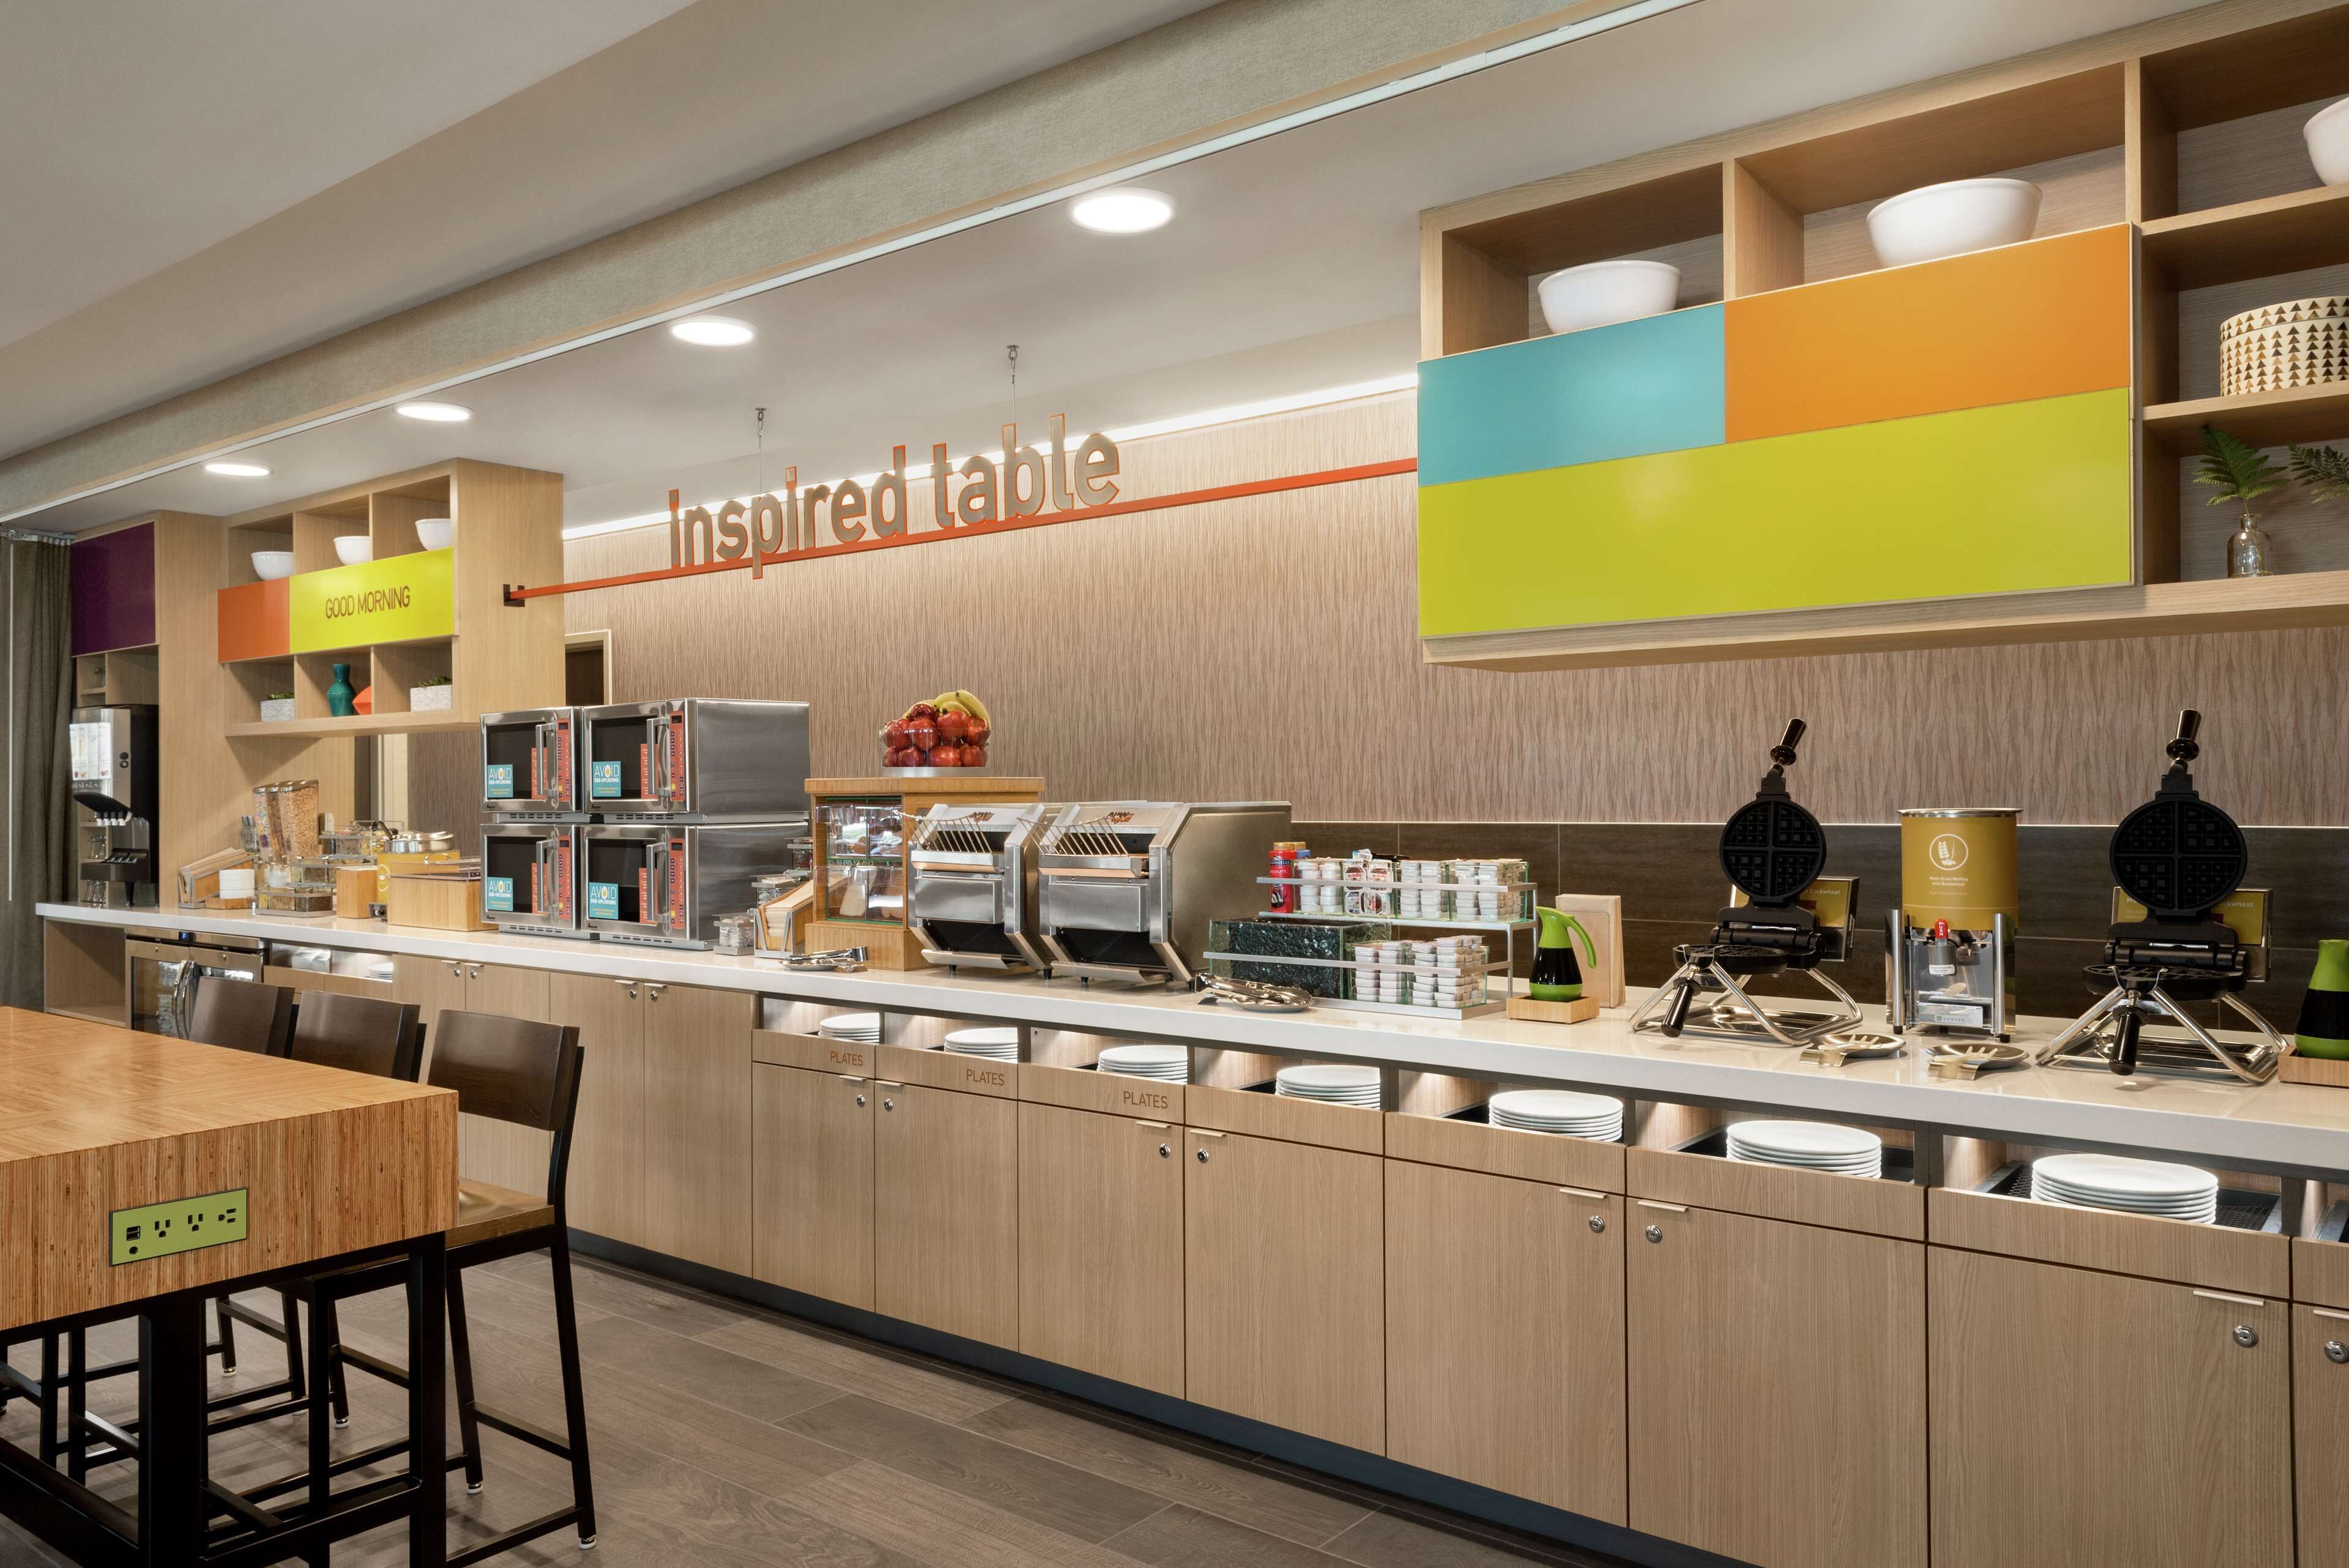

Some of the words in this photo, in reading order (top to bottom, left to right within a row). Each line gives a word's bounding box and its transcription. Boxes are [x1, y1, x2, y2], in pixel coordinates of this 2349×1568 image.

[669, 445, 907, 580] inspired
[930, 412, 1120, 530] table
[326, 598, 355, 619] GOOD
[357, 585, 411, 615] MORNING
[488, 767, 512, 780] AVOID
[594, 764, 619, 778] AVOID
[488, 880, 512, 893] AVOID
[590, 885, 617, 900] AVOID
[830, 1051, 863, 1066] PLATES
[966, 1069, 1005, 1086] PLATES
[1123, 1091, 1168, 1109] PLATES
